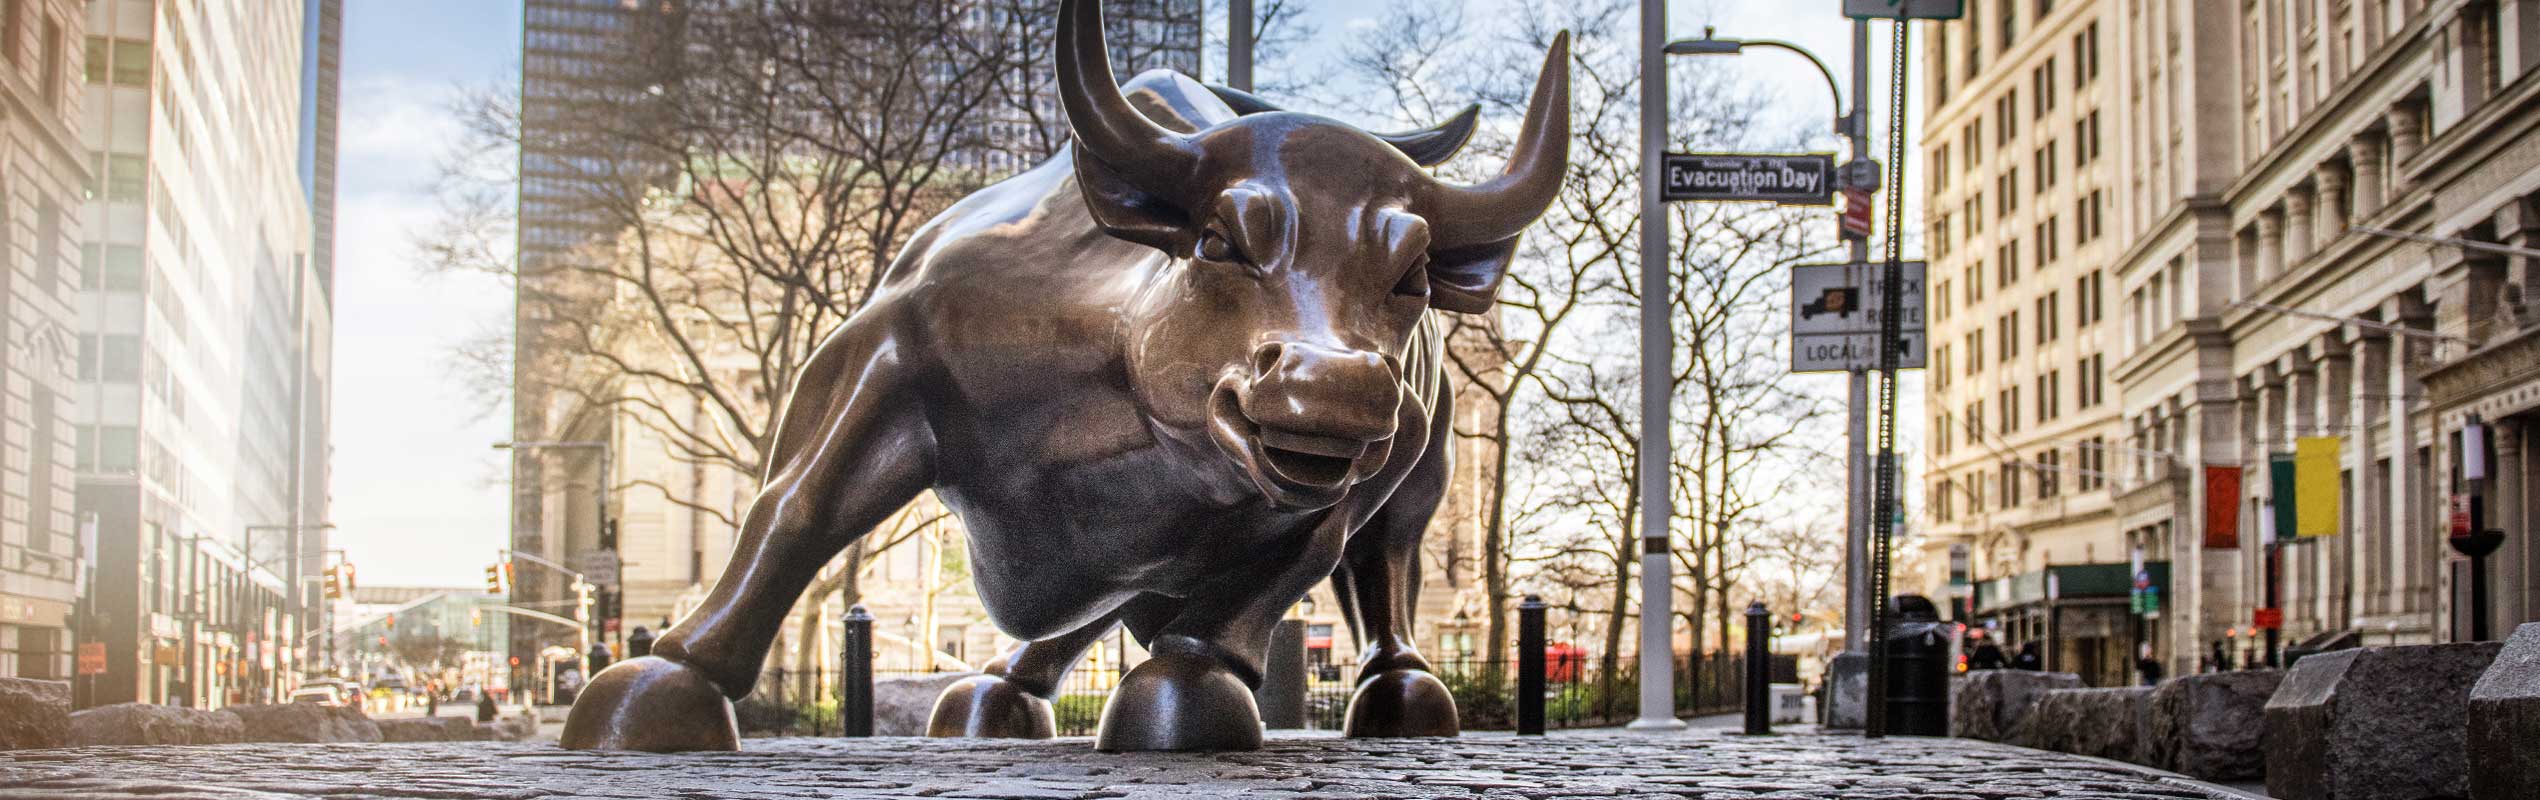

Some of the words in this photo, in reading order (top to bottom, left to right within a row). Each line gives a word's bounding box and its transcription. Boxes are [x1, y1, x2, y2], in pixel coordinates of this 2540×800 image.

[1670, 167, 1779, 188] Evacuation
[1781, 167, 1820, 193] Day
[1868, 279, 1920, 296] TRCK
[1806, 344, 1860, 361] LOCAL
